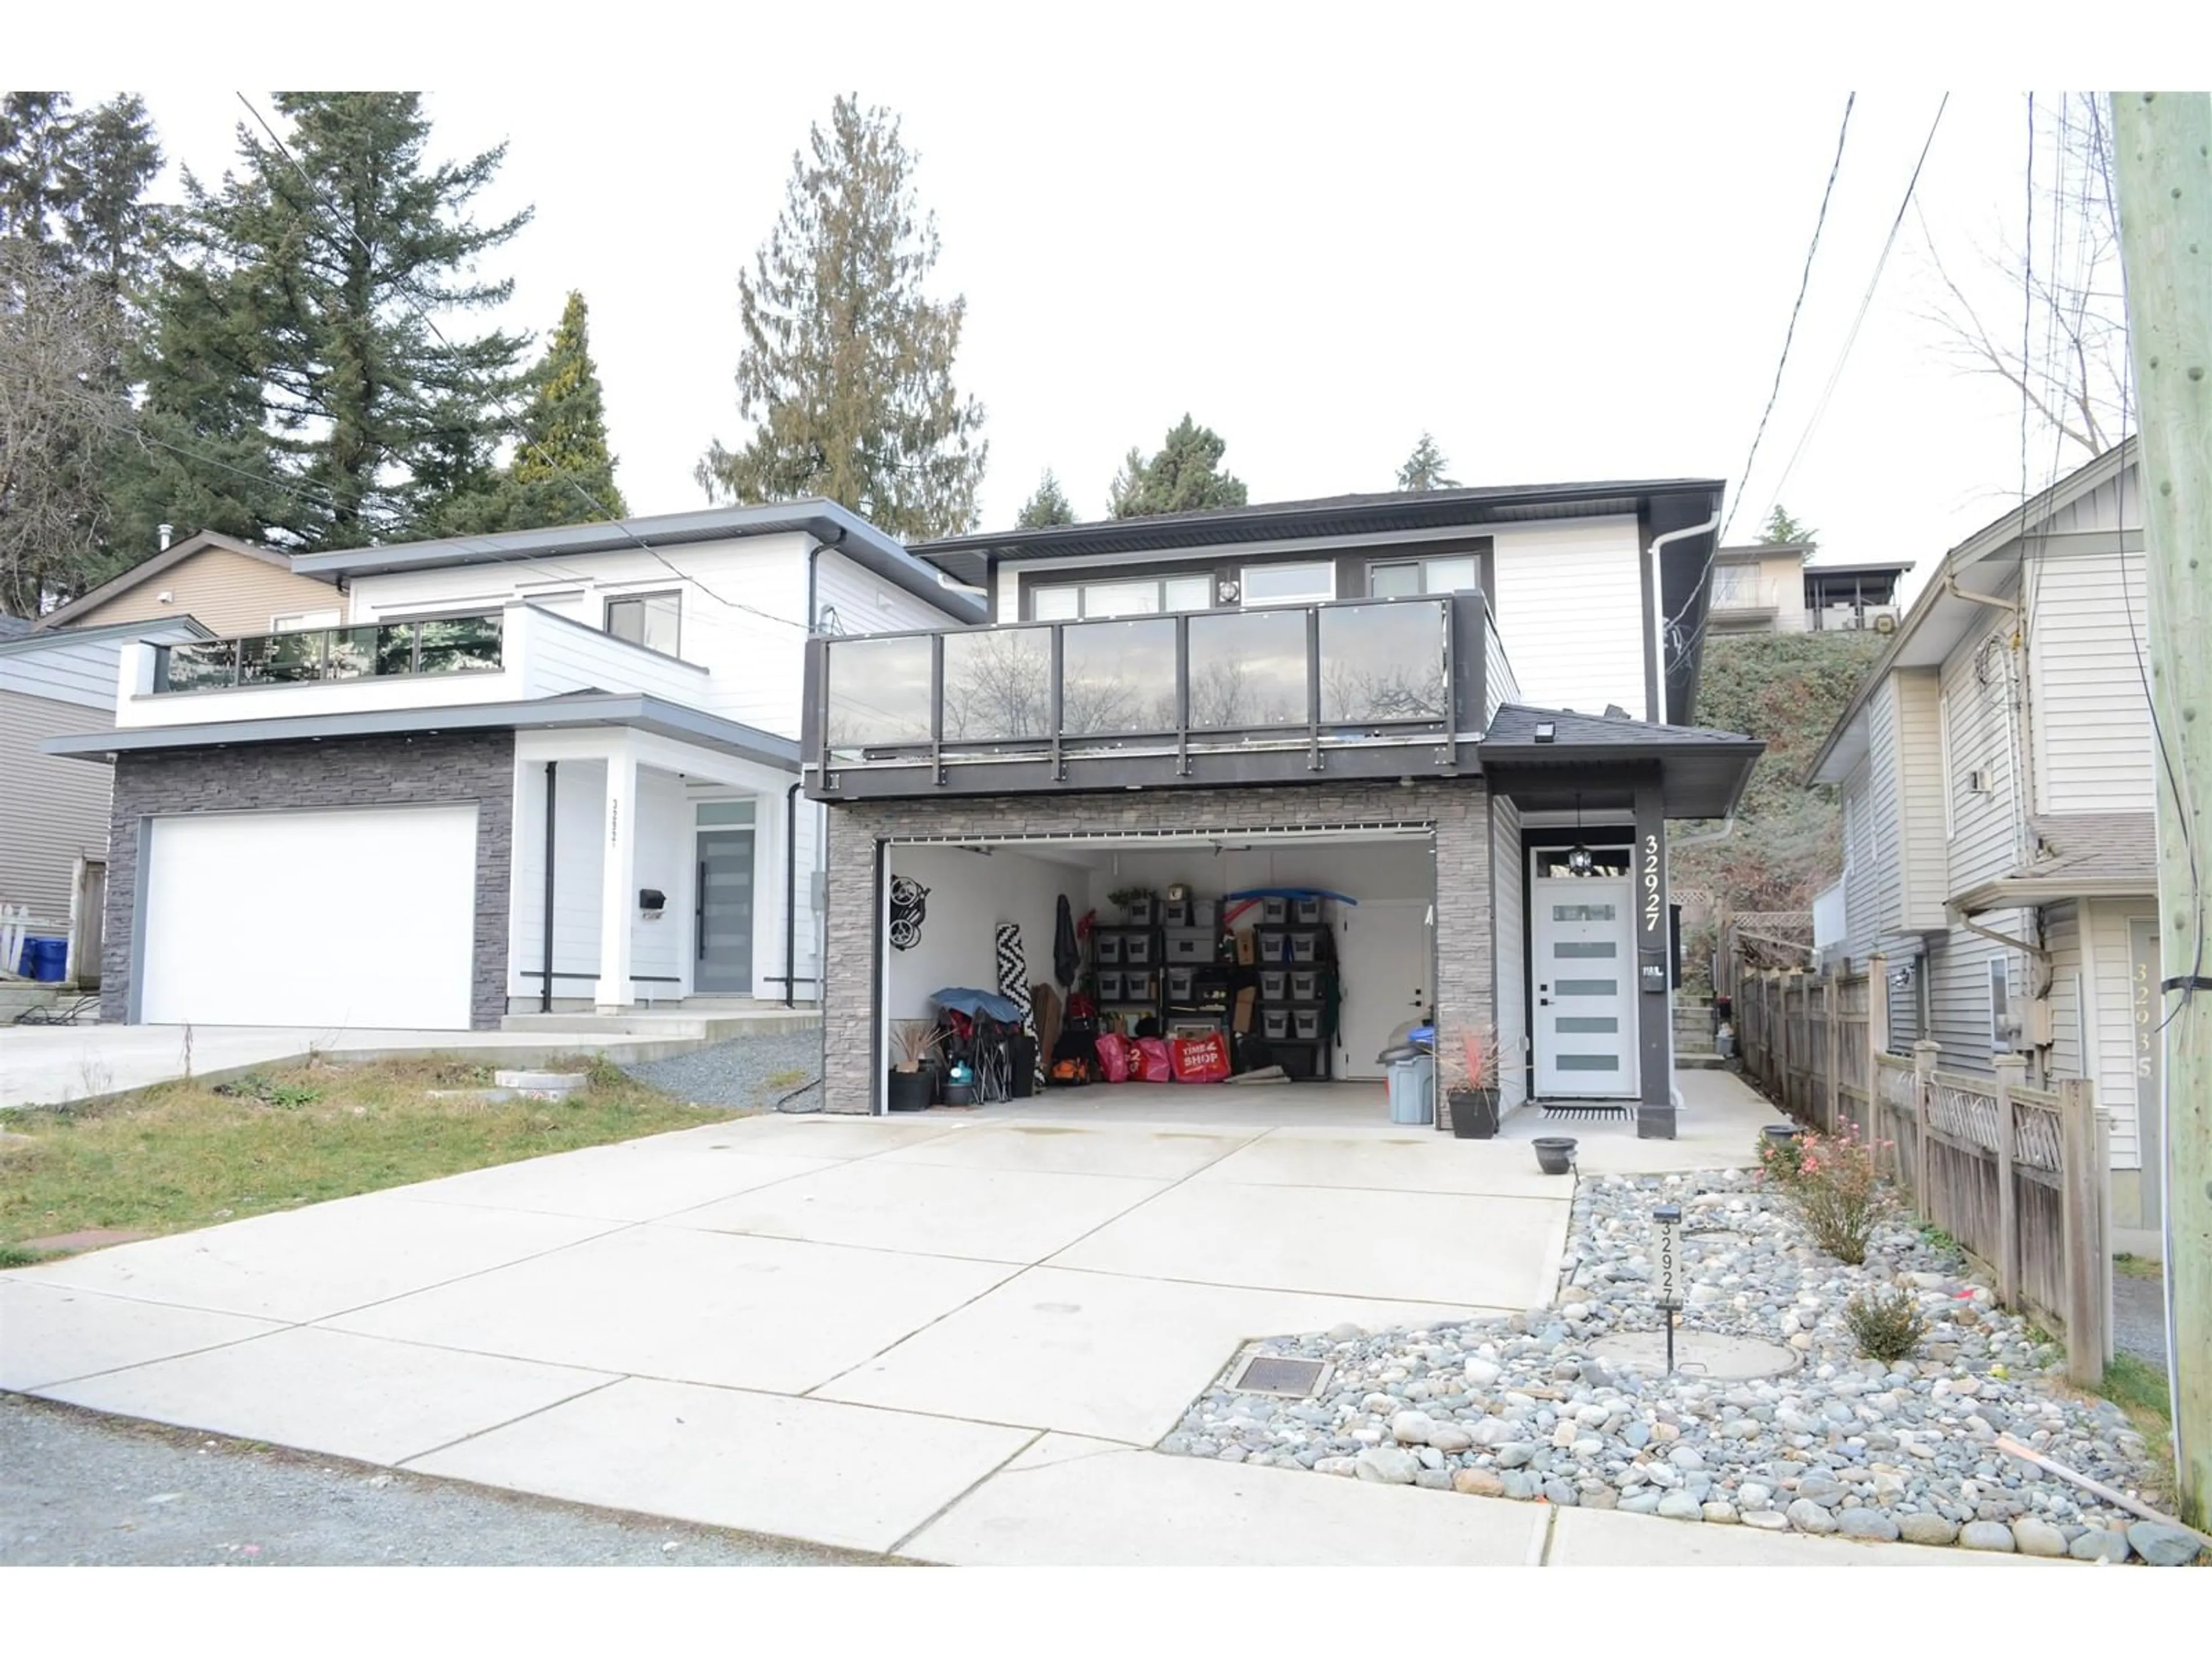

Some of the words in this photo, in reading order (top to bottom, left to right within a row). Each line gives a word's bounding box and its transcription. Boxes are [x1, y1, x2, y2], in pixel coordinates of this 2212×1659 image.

[1643, 835, 1660, 931] 32927
[1184, 1053, 1218, 1067] SHOP
[2134, 963, 2152, 1080] 32935
[1661, 1220, 1673, 1304] 32927
